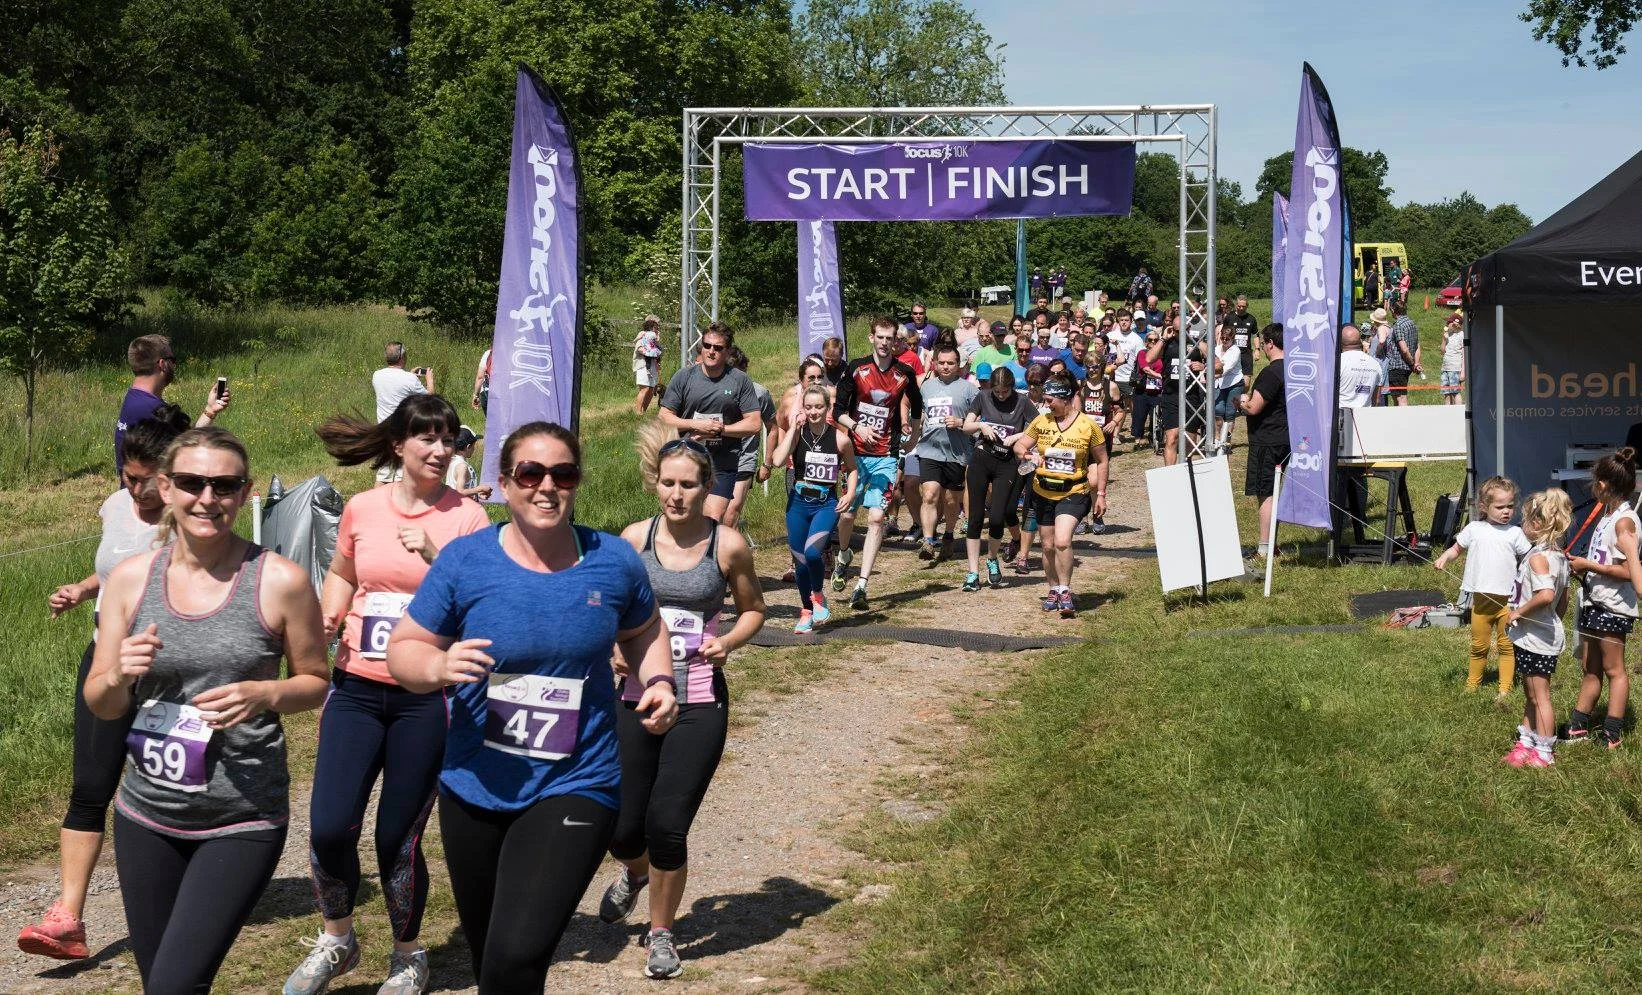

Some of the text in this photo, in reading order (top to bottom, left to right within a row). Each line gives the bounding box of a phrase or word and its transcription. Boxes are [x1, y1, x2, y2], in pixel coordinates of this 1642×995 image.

[904, 145, 969, 159] focus 10K
[787, 164, 1089, 200] START FINISH
[858, 413, 885, 431] 298
[928, 406, 951, 419] 473
[806, 464, 834, 480] 301
[370, 620, 393, 652] 6
[670, 635, 687, 661] 8
[502, 708, 560, 749] 47
[143, 737, 187, 782] 59
